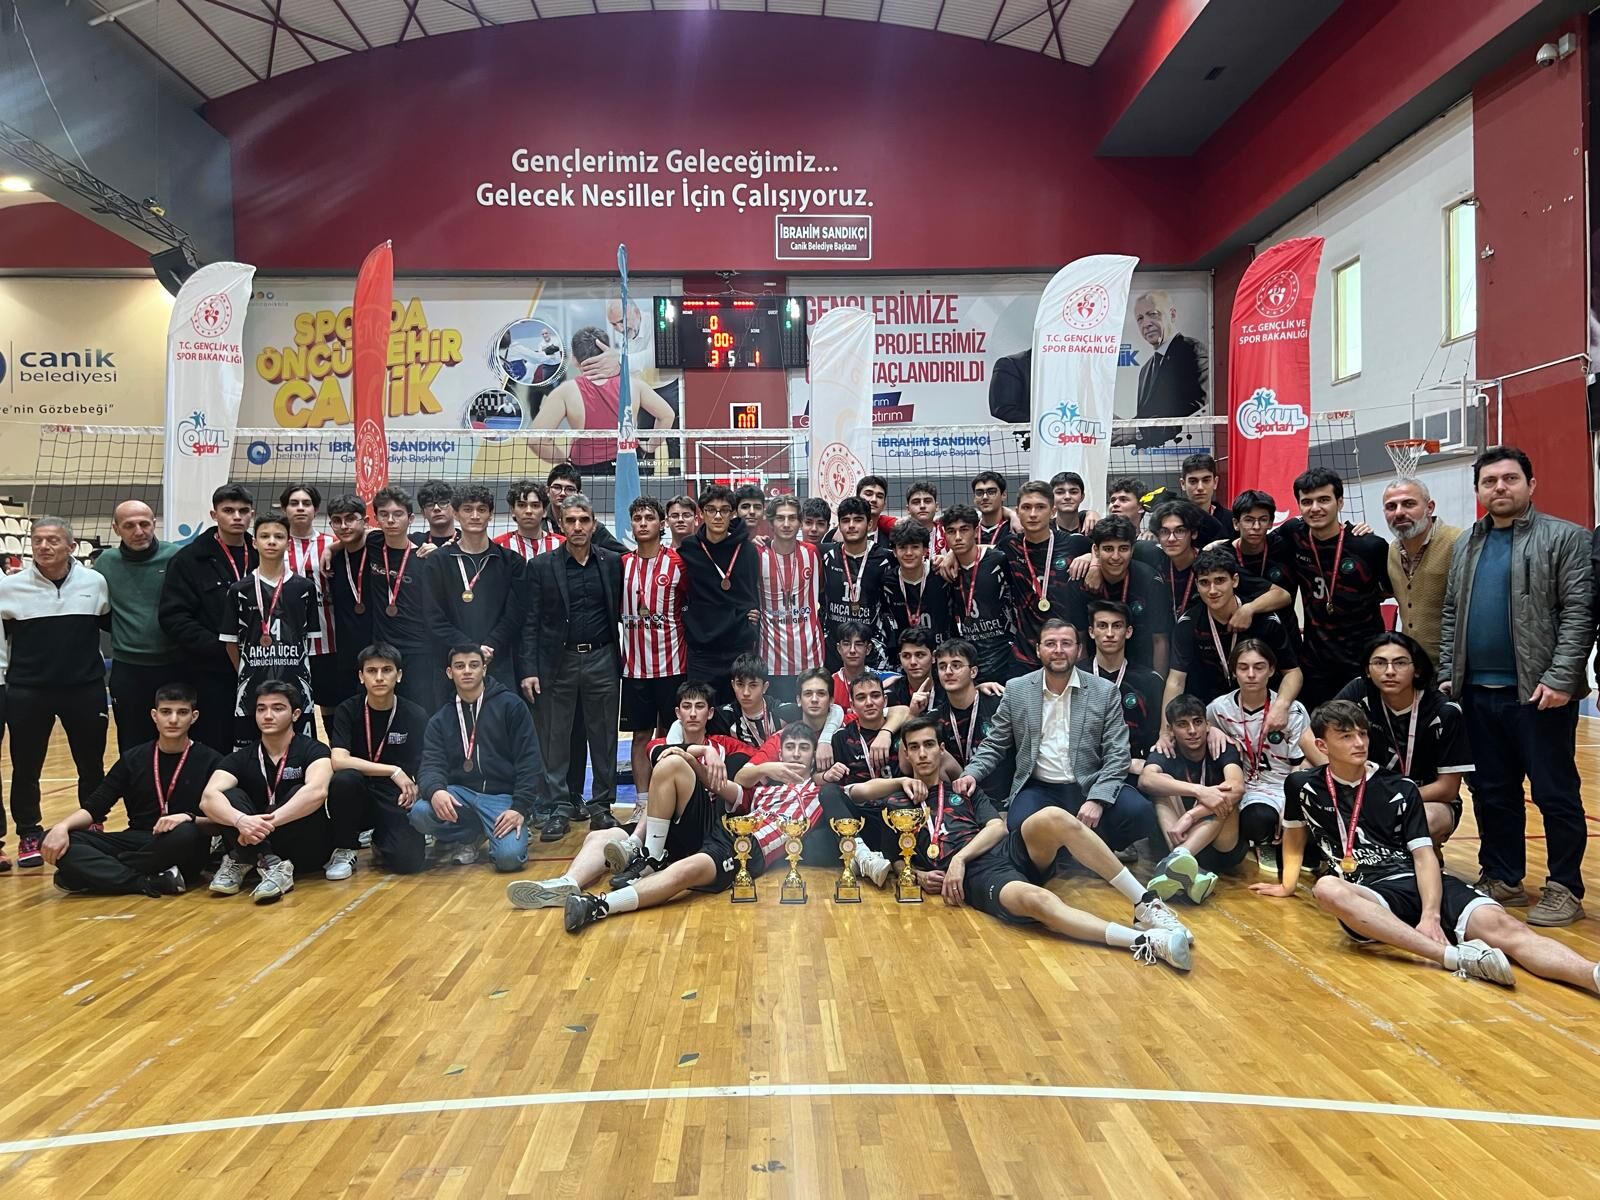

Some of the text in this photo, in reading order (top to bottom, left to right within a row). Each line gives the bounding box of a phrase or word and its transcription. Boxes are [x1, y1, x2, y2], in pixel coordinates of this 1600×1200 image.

[511, 148, 838, 178] Gençlerimiz Geleceğimiz...
[475, 178, 874, 213] Gelecek Nesiller İçin Çalışıyoruz.
[780, 223, 867, 241] İBRAHİM SANDIKÇI
[790, 242, 857, 252] Canik Belediye Başkanı
[1242, 319, 1306, 334] T.C. GENÇLİK VE
[875, 328, 987, 355] PROJELERİMİZ
[1046, 333, 1116, 344] T.C. GENÇLİK VE
[1239, 329, 1308, 345] SPOR BAKANLIĞI
[194, 341, 228, 354] GENÇLİK
[230, 345, 240, 353] VE
[1042, 345, 1067, 353] SPOR
[1068, 344, 1117, 354] BAKANLIĞI
[20, 349, 116, 368] canik
[176, 352, 242, 364] SPOR BAKANLIĞI
[728, 350, 735, 364] 5
[20, 370, 117, 384] belediyesi
[276, 440, 319, 452] canik
[390, 441, 455, 454] SANDIKÇI
[913, 449, 948, 458] Belediye
[409, 454, 445, 464] Başkanı
[1313, 576, 1326, 599] 3
[270, 618, 281, 641] 4
[250, 642, 299, 658] AKÇA ÜÇEL
